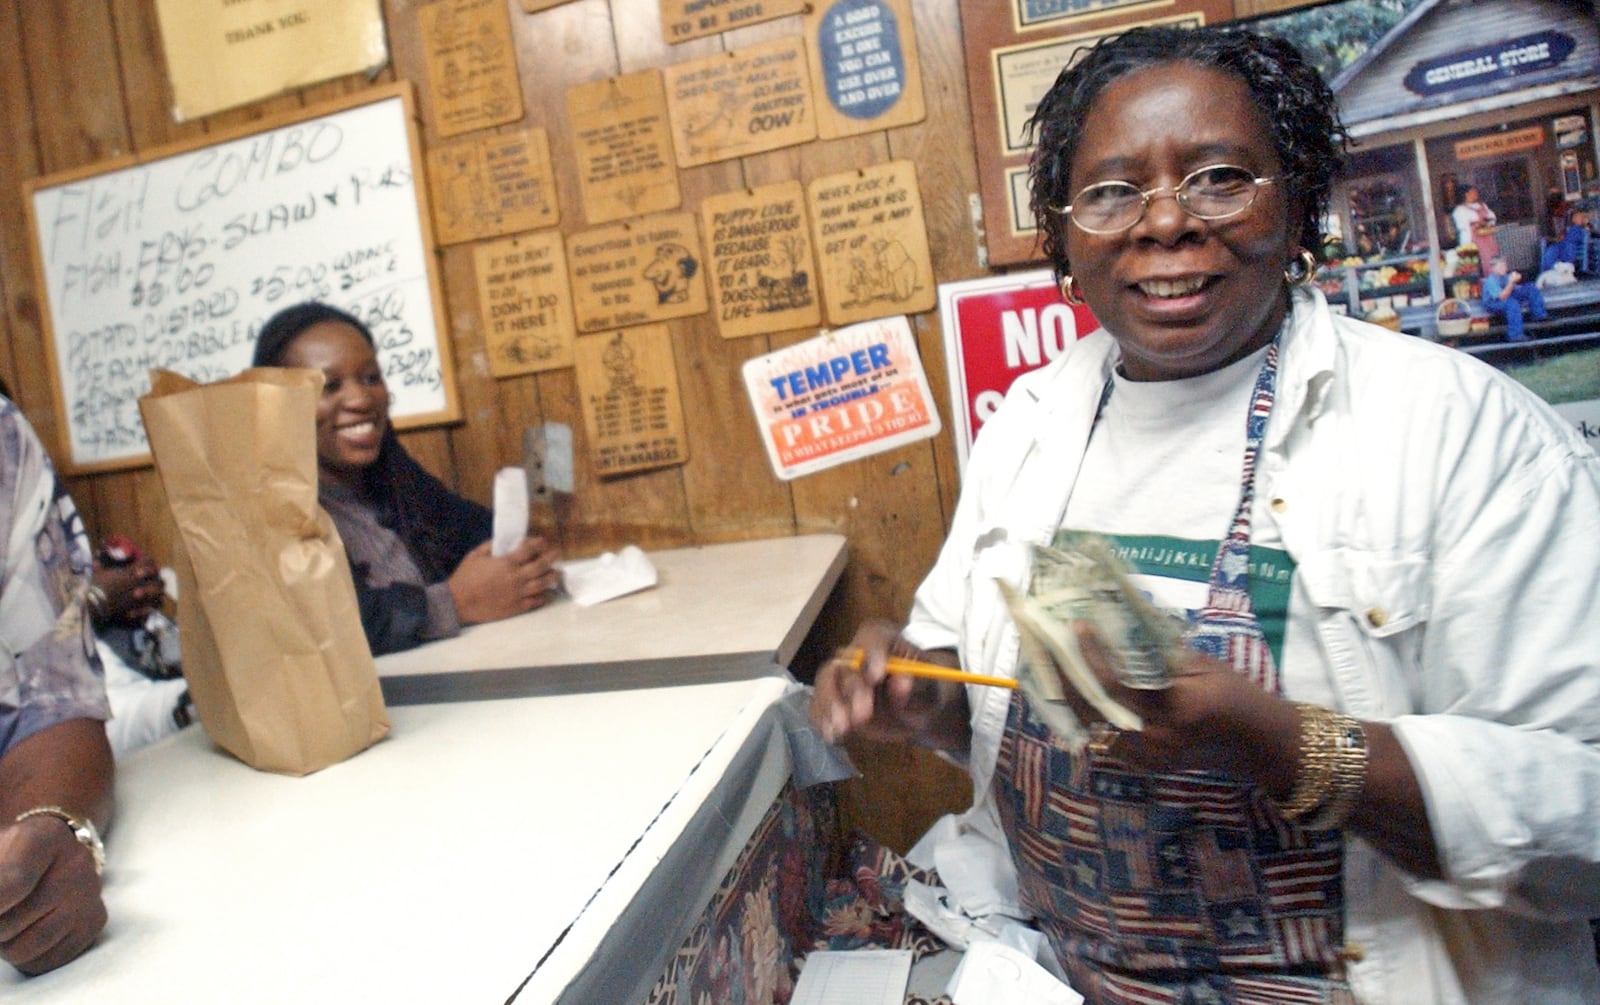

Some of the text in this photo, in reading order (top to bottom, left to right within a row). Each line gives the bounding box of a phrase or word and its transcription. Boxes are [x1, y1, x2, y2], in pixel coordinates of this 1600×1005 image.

[671, 22, 691, 36] TO
[699, 15, 717, 29] BE
[728, 3, 763, 22] NICE
[834, 5, 880, 27] A GOOD
[225, 21, 275, 44] THANK
[836, 21, 882, 43] EXCUSE
[841, 37, 880, 57] IS ONE
[837, 50, 891, 73] YOU CAN
[1425, 43, 1550, 84] GENERAL STORE
[837, 66, 897, 91] USE OVER
[839, 81, 900, 106] AND OVER
[1460, 133, 1536, 154] GENERAL STORE
[176, 121, 344, 212] COMBO
[714, 200, 794, 225] PUPPY LOVE
[714, 236, 770, 256] BECAUSE
[825, 239, 847, 254] GET
[717, 253, 770, 272] IT LEADS
[720, 273, 747, 287] TO A
[491, 294, 558, 318] DON'T DO
[722, 304, 752, 320] LIFE
[494, 321, 504, 332] IT
[1002, 303, 1078, 369] NO
[770, 343, 893, 400] TEMPER
[786, 397, 811, 409] what
[814, 388, 837, 400] gets
[841, 378, 868, 391] most
[871, 373, 882, 382] of
[885, 369, 898, 379] us
[781, 385, 917, 447] PRIDE
[791, 409, 807, 419] IN
